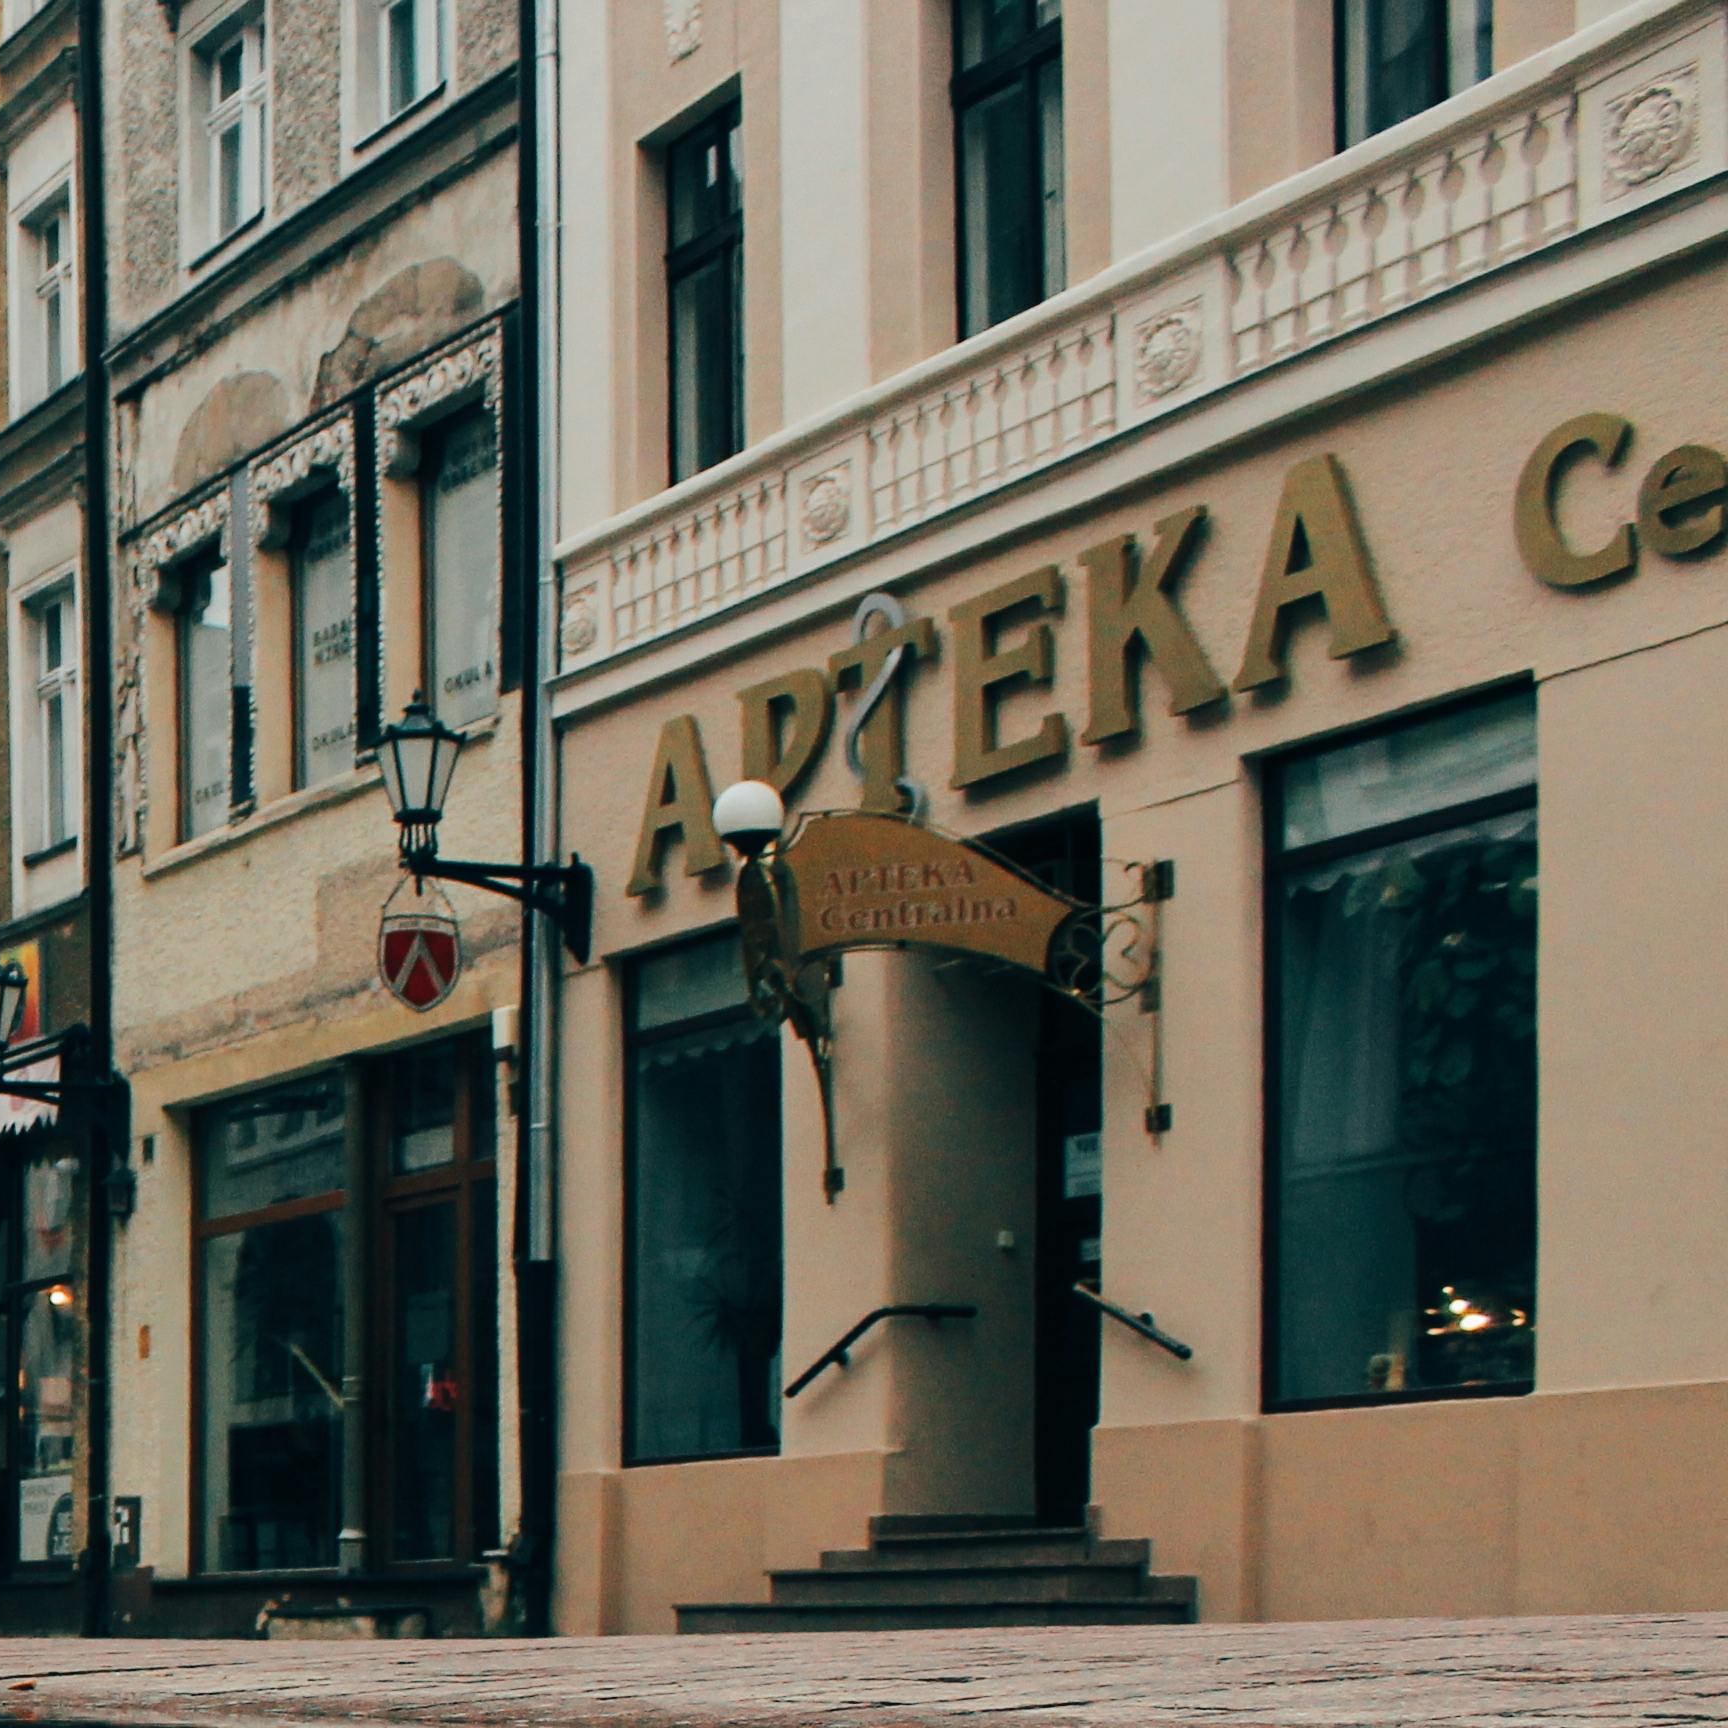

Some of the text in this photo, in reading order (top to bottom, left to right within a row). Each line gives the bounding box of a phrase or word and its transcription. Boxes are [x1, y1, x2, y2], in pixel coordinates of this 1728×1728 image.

[626, 455, 1397, 898] APTEKA
[823, 860, 975, 896] APTEKA
[819, 897, 1017, 930] Centralna
